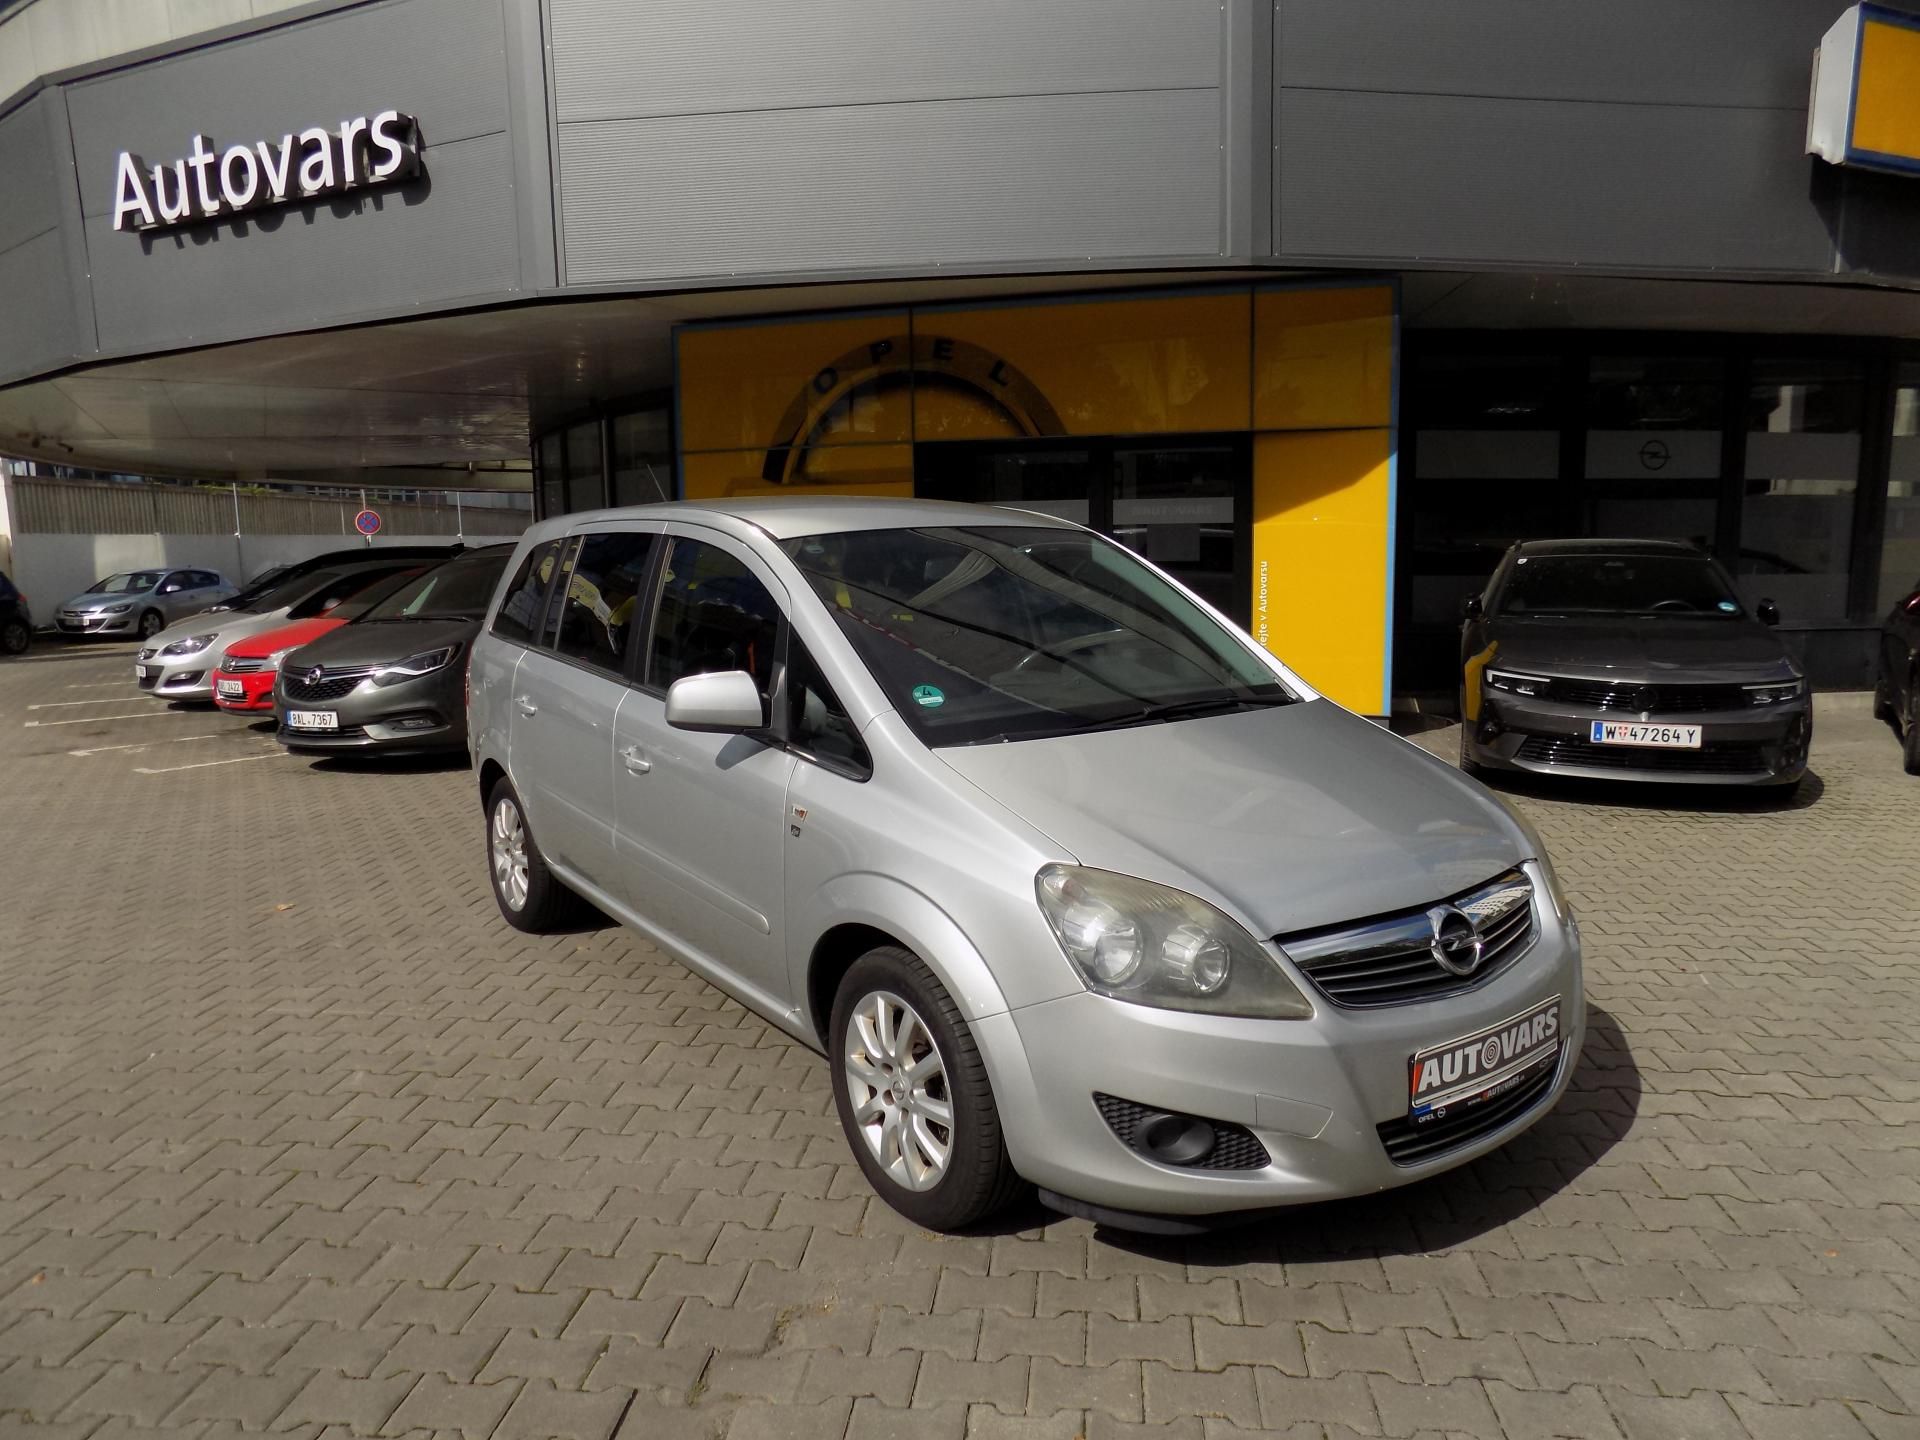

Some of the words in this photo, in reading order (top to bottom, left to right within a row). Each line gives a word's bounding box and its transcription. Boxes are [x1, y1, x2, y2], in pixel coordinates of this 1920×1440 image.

[113, 110, 403, 231] Autovars
[813, 339, 1009, 394] OPEL
[1259, 560, 1268, 613] Autovarsu
[311, 713, 333, 726] 7367
[1605, 725, 1617, 740] W
[1629, 727, 1681, 743] 47264
[1687, 729, 1696, 743] Y
[1417, 1006, 1558, 1092] AUTOVARS
